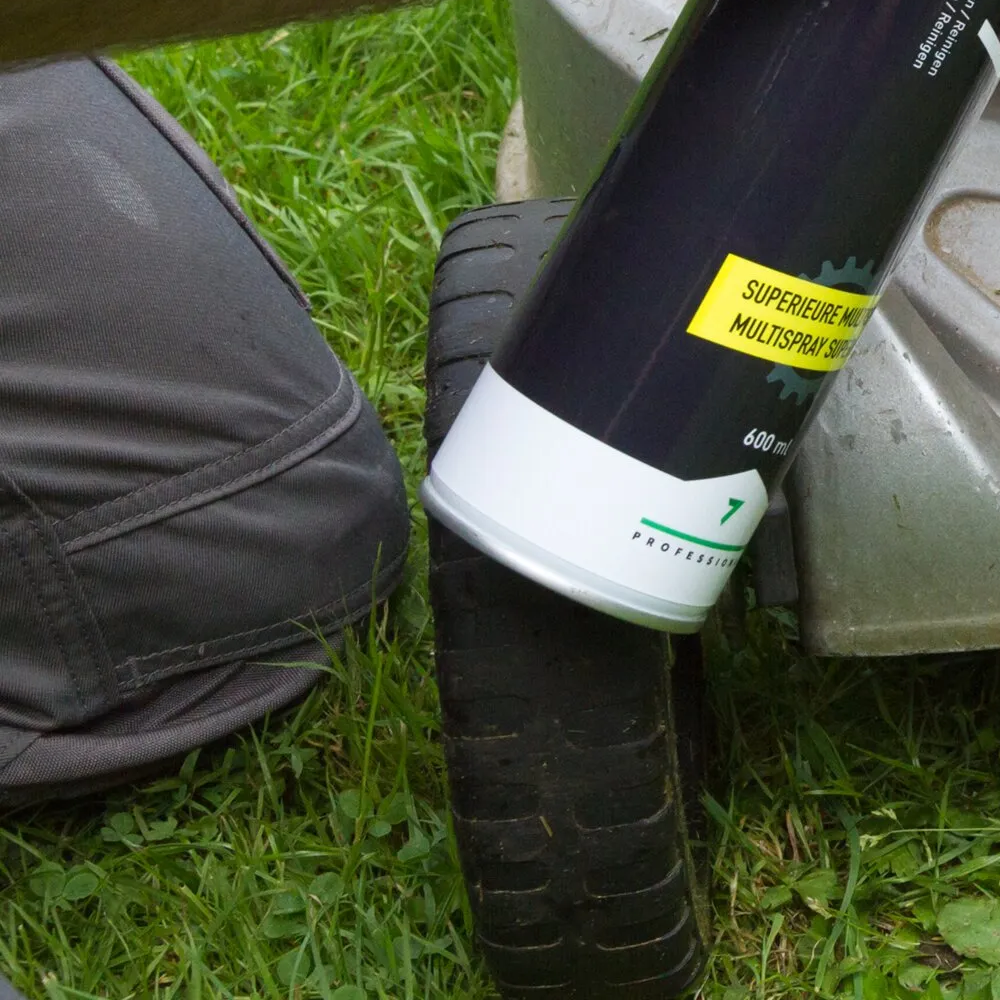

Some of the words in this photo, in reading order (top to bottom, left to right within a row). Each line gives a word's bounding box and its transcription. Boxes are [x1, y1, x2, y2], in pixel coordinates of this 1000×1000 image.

[913, 12, 951, 69] Reinigen
[928, 20, 966, 77] Reinigen
[742, 279, 843, 325] SUPERIEURE
[729, 313, 828, 357] MULTISPRAY
[743, 428, 776, 452] 600
[772, 439, 793, 456] ml
